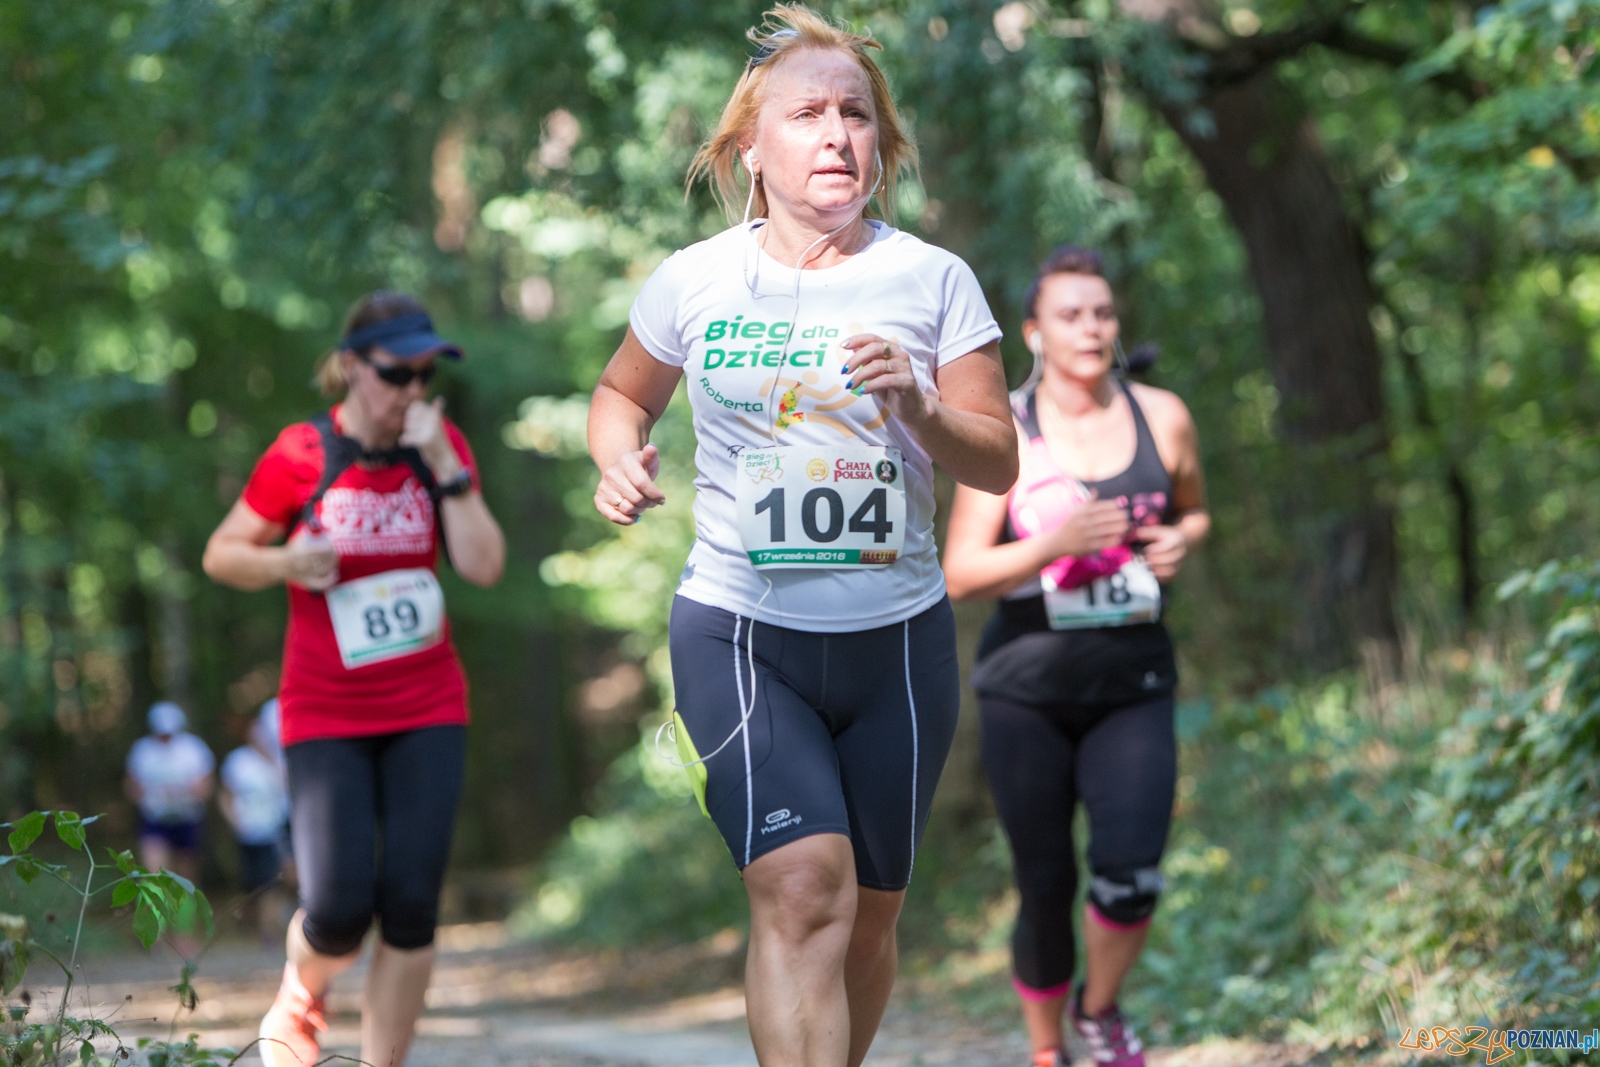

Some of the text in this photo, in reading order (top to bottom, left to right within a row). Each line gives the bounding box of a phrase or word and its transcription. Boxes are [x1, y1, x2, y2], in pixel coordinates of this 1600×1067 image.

[704, 315, 839, 346] Bieg dla
[703, 343, 828, 370] Dzieci
[699, 376, 764, 413] Roberta
[746, 453, 765, 461] Bieg
[754, 487, 893, 543] 104
[757, 552, 771, 561] 17
[816, 552, 846, 561] 2016
[362, 598, 420, 641] 89
